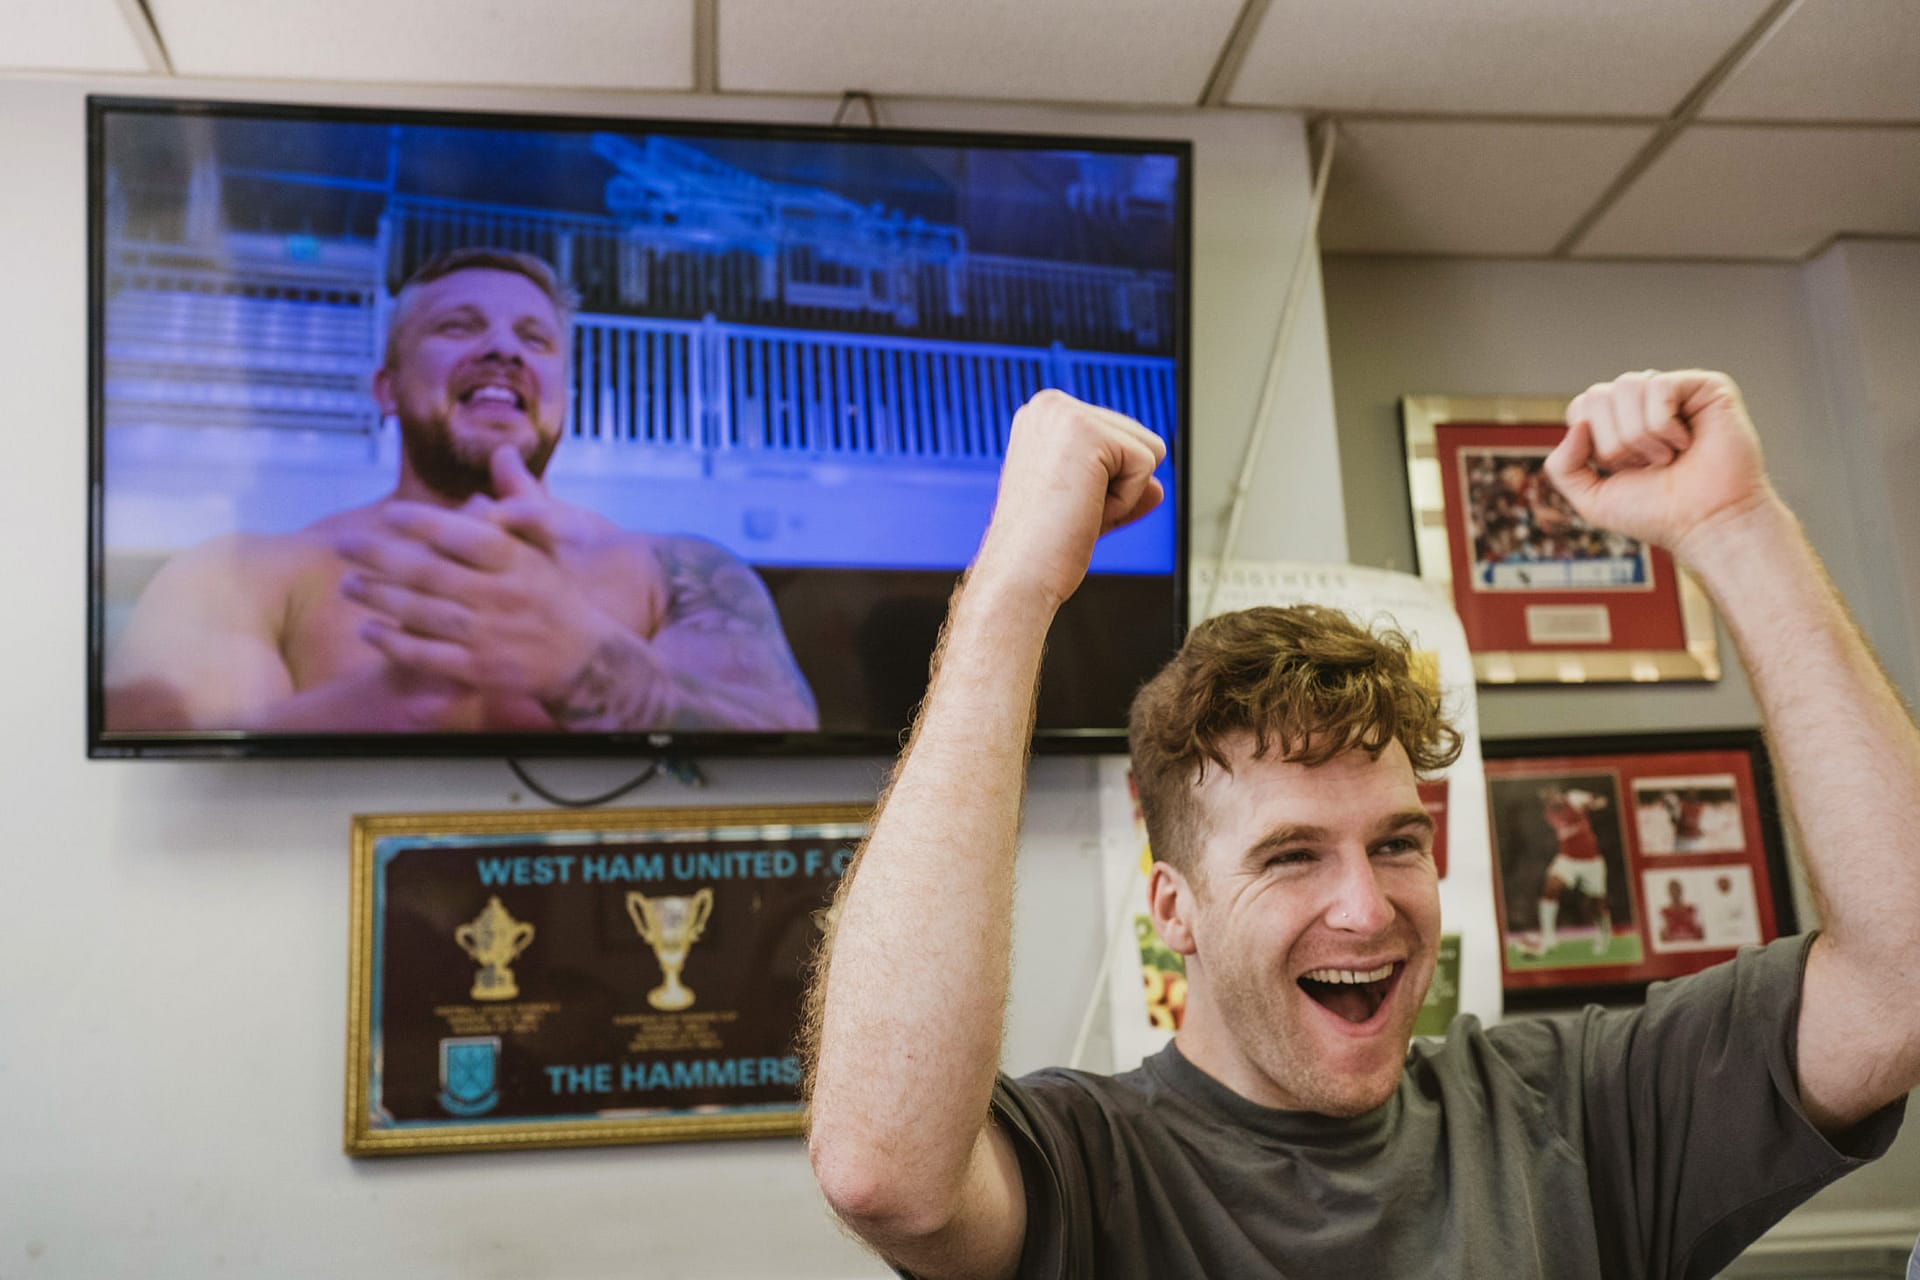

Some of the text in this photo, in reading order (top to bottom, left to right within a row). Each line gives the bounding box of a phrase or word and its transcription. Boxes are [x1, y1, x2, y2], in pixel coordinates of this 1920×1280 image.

[477, 855, 576, 886] WEST
[582, 853, 665, 883] HAM
[671, 850, 798, 880] UNITED
[544, 1056, 802, 1094] THE HAMMERS
